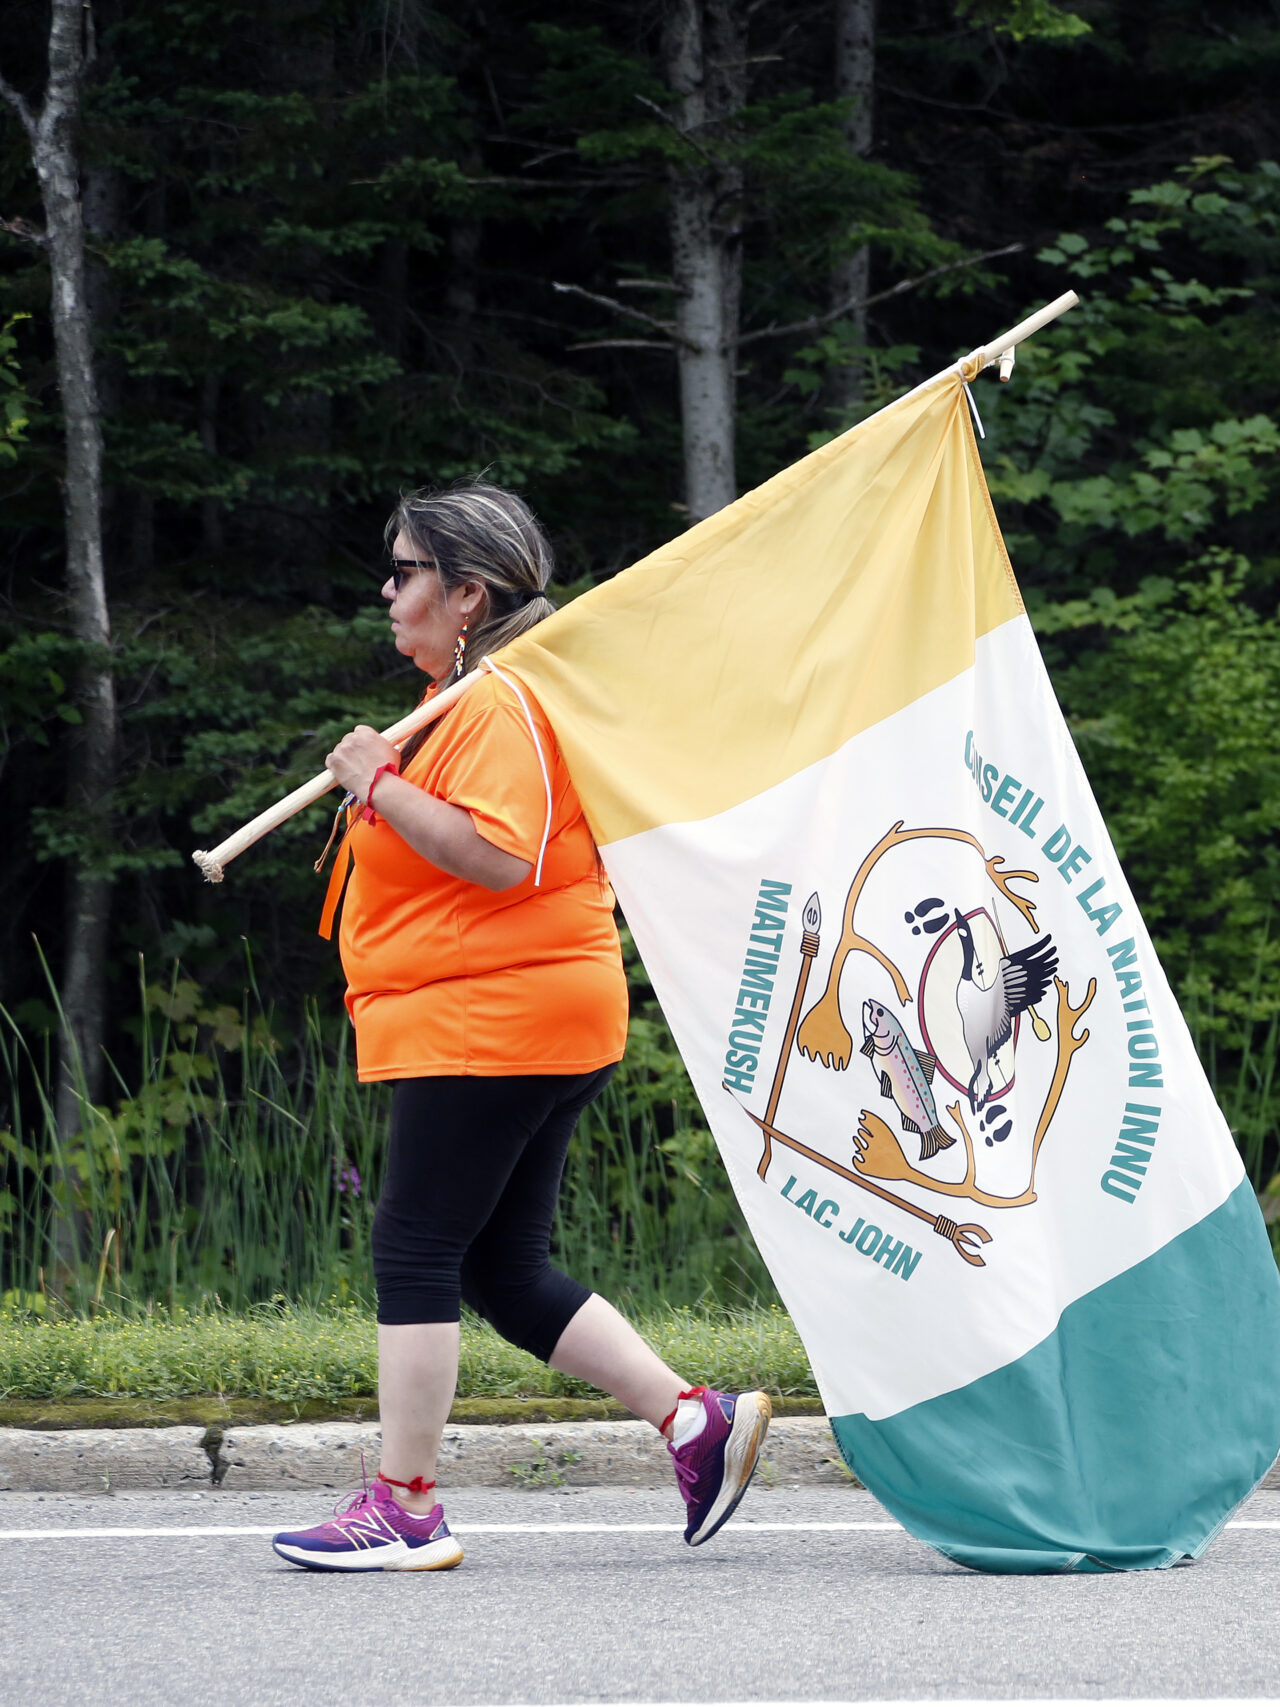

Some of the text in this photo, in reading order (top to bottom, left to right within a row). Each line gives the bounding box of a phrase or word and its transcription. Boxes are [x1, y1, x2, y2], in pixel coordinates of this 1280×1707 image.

[1041, 823, 1092, 884] DE
[1076, 876, 1123, 937] LA
[722, 878, 793, 1094] MATIMEKUSH
[1106, 937, 1164, 1088] NATION
[1100, 1101, 1162, 1204] INNU
[780, 1174, 923, 1281] LAC JOHN
